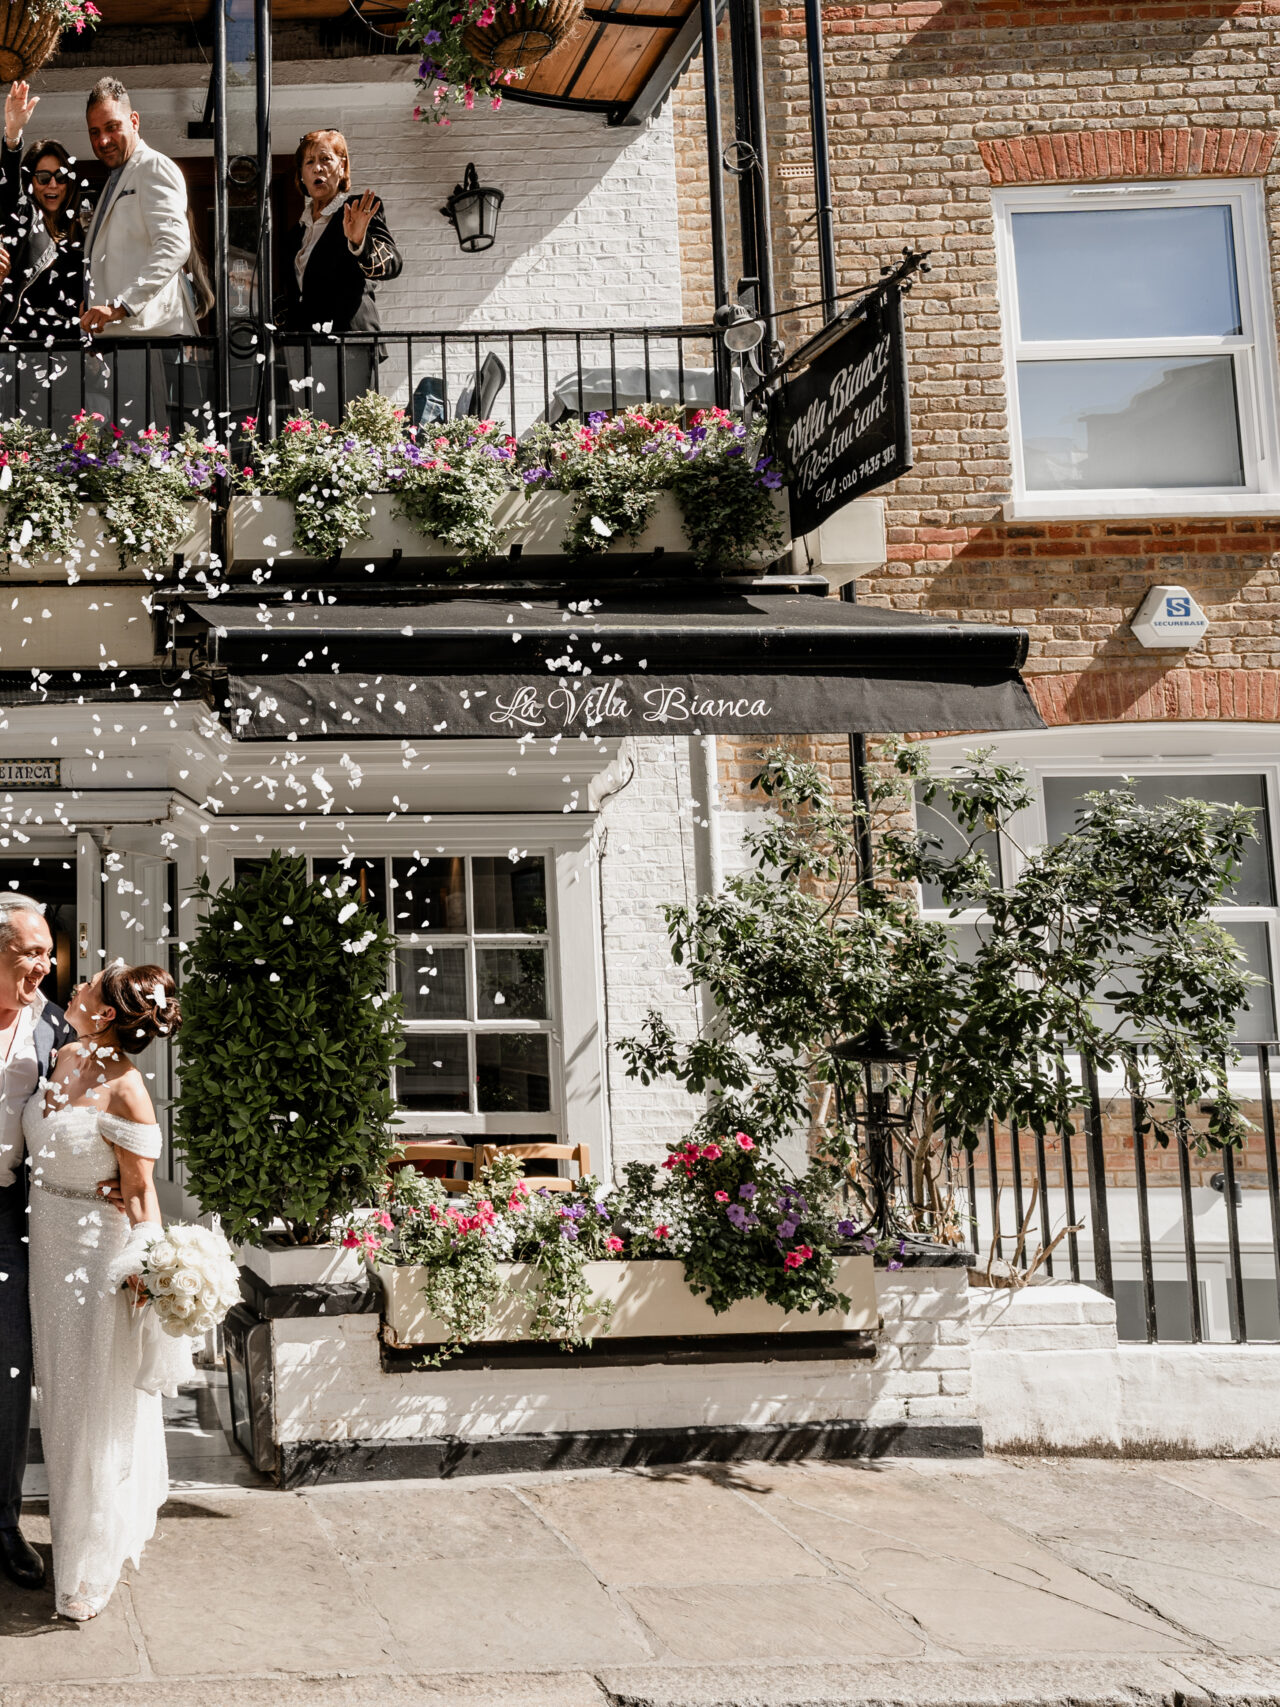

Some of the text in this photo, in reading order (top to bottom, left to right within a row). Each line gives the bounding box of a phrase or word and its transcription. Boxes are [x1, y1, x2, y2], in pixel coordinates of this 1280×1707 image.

[787, 398, 827, 464] Villa
[859, 453, 881, 479] 7435
[489, 682, 772, 727] La Villa Bianca
